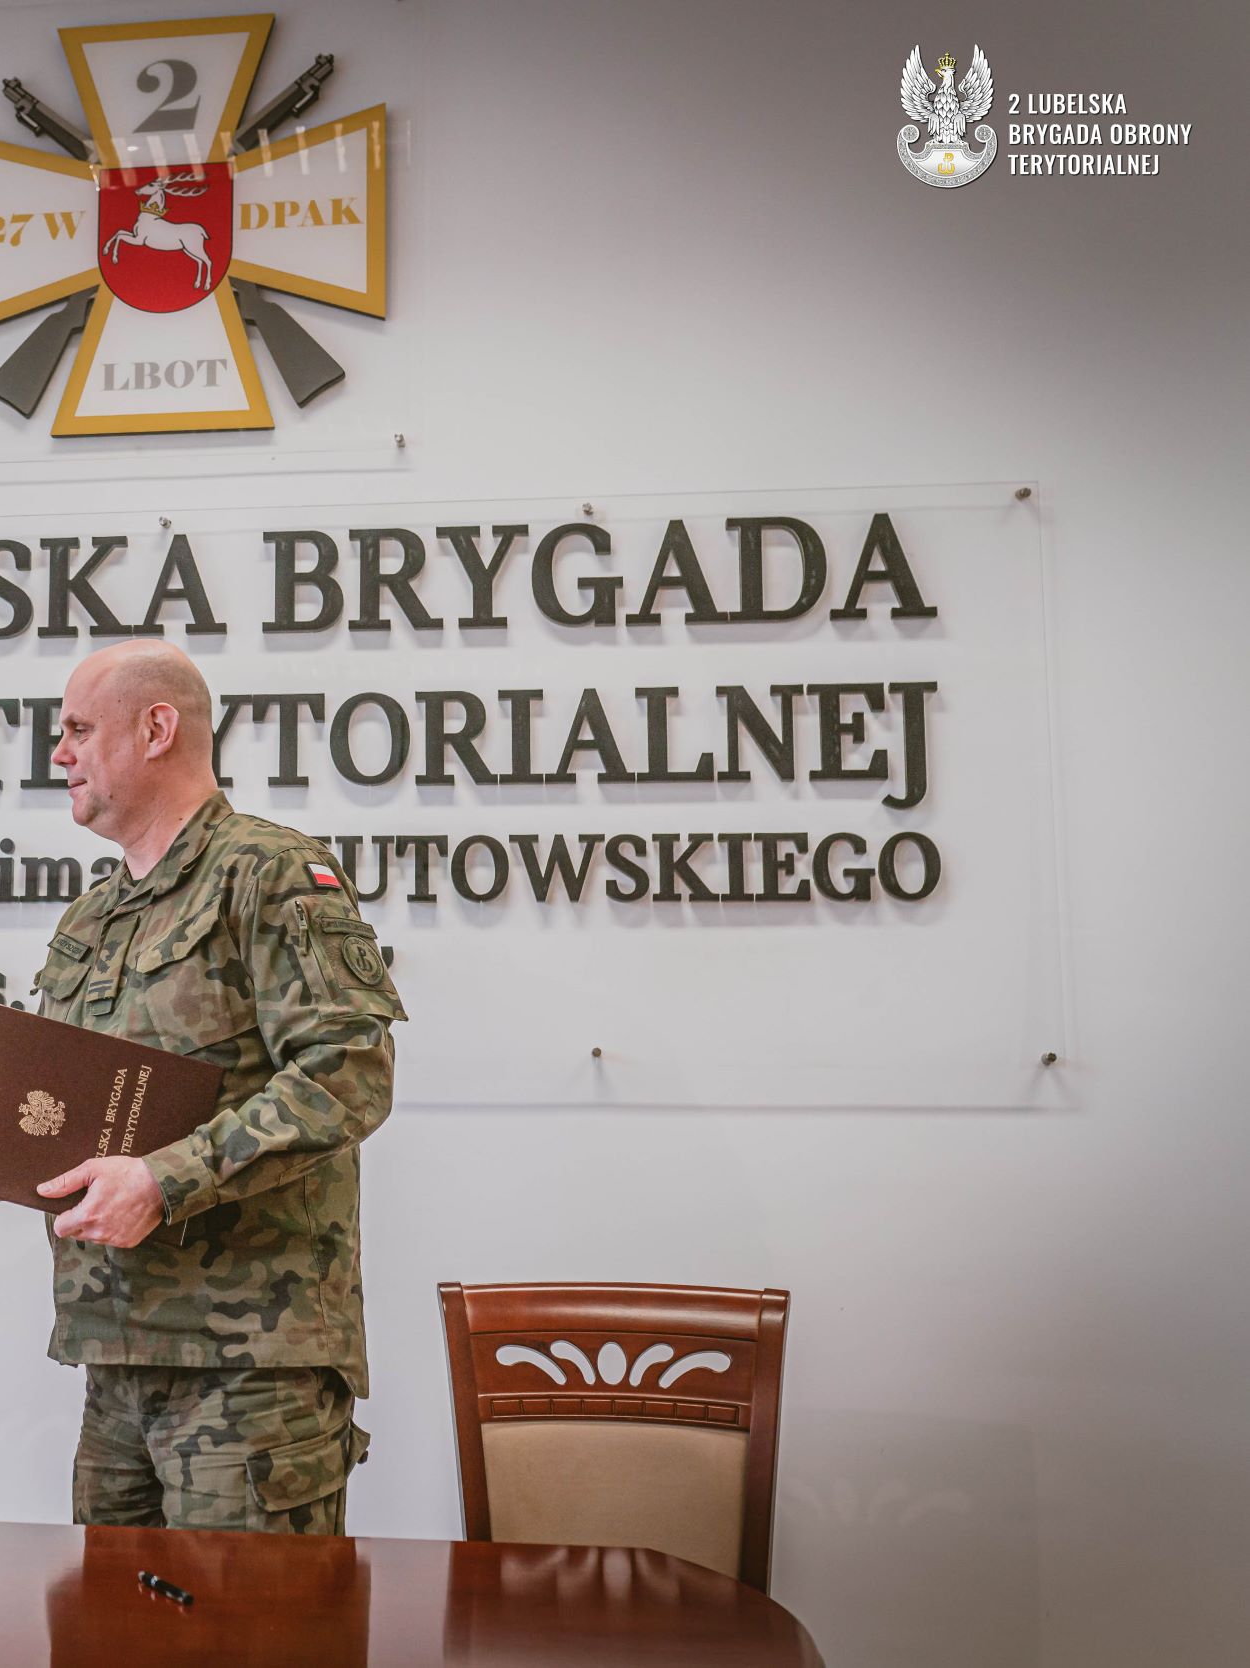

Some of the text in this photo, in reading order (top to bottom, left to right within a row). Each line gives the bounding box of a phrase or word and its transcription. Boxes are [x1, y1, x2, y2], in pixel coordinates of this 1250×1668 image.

[134, 59, 201, 133] 2
[43, 210, 86, 240] W
[239, 197, 363, 231] DPAK
[102, 358, 228, 392] LBOT
[262, 512, 937, 632] BRYGADA
[105, 1068, 128, 1123] BRYGADA
[120, 1064, 153, 1154] TERYTORIALNEJ
